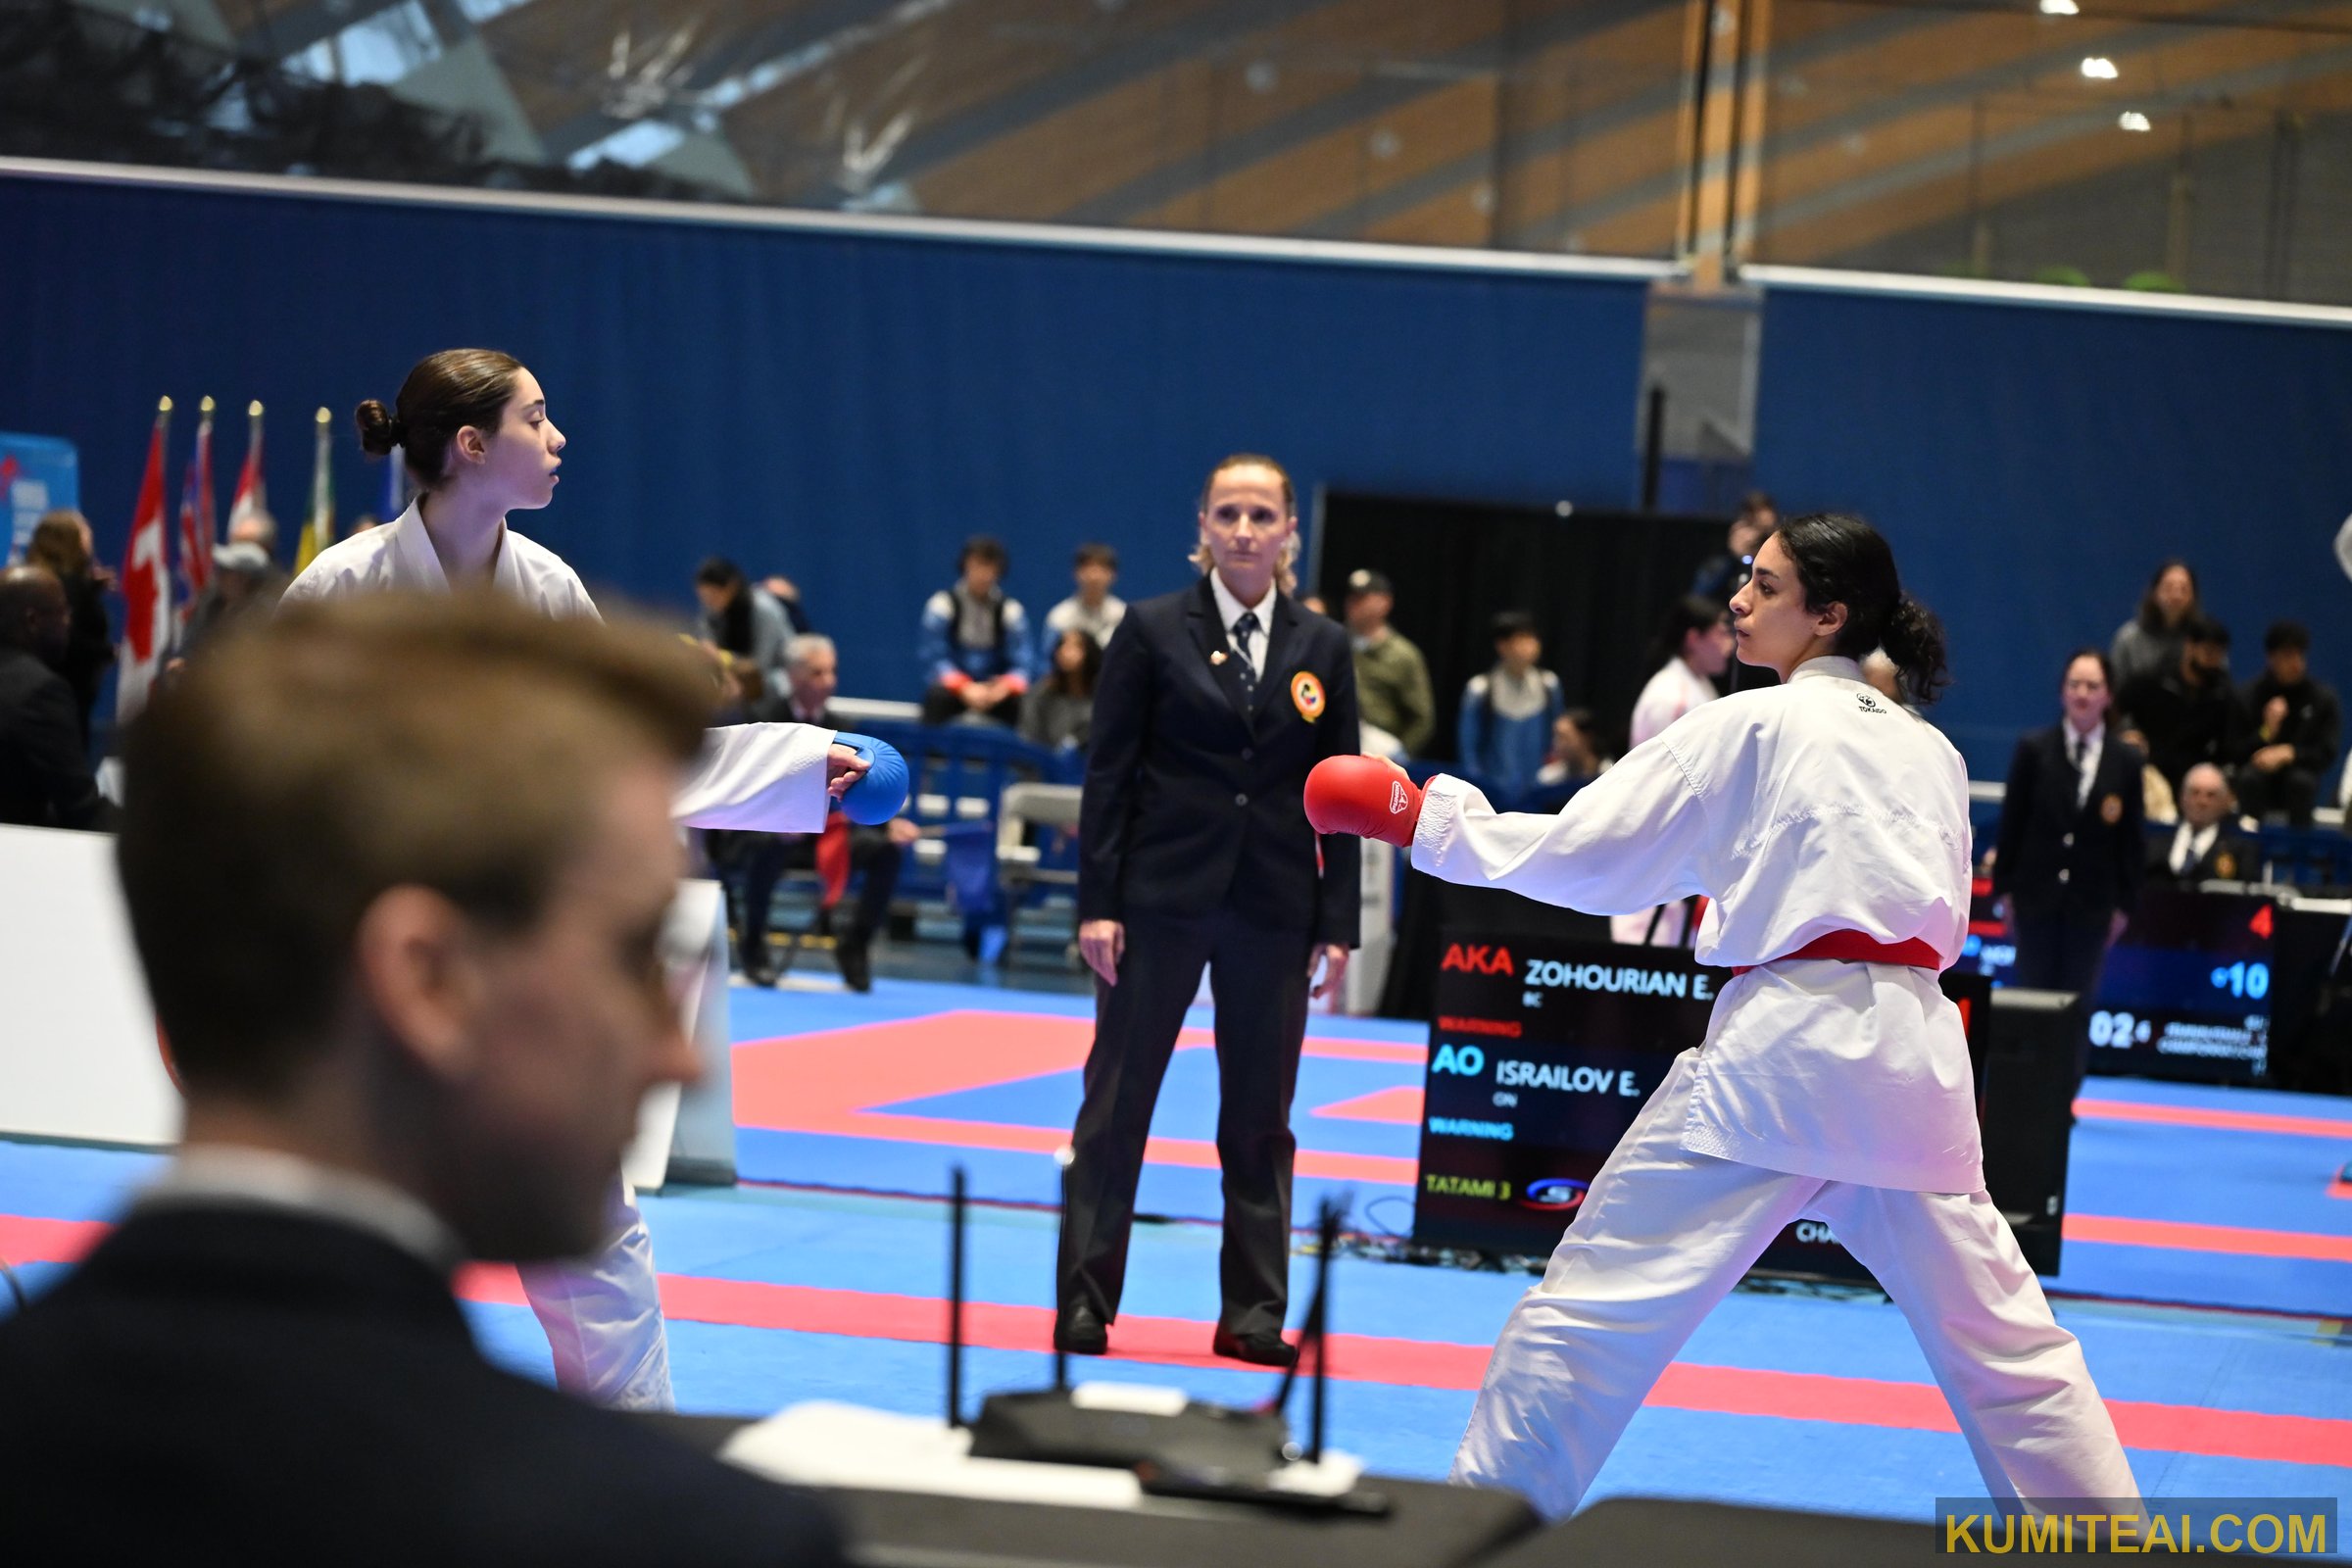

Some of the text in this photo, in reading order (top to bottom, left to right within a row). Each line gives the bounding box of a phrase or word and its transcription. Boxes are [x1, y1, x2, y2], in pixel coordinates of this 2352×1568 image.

[2249, 904, 2273, 939] 4
[1441, 942, 1514, 977] AKA
[1524, 958, 1715, 1001] ZOHOURIAN E.
[2228, 960, 2270, 1000] 10
[1431, 1044, 1485, 1076] AO
[1495, 1059, 1642, 1097] ISRAILOV E.
[1429, 1116, 1514, 1141] WARNING
[1426, 1174, 1496, 1198] TATAMI
